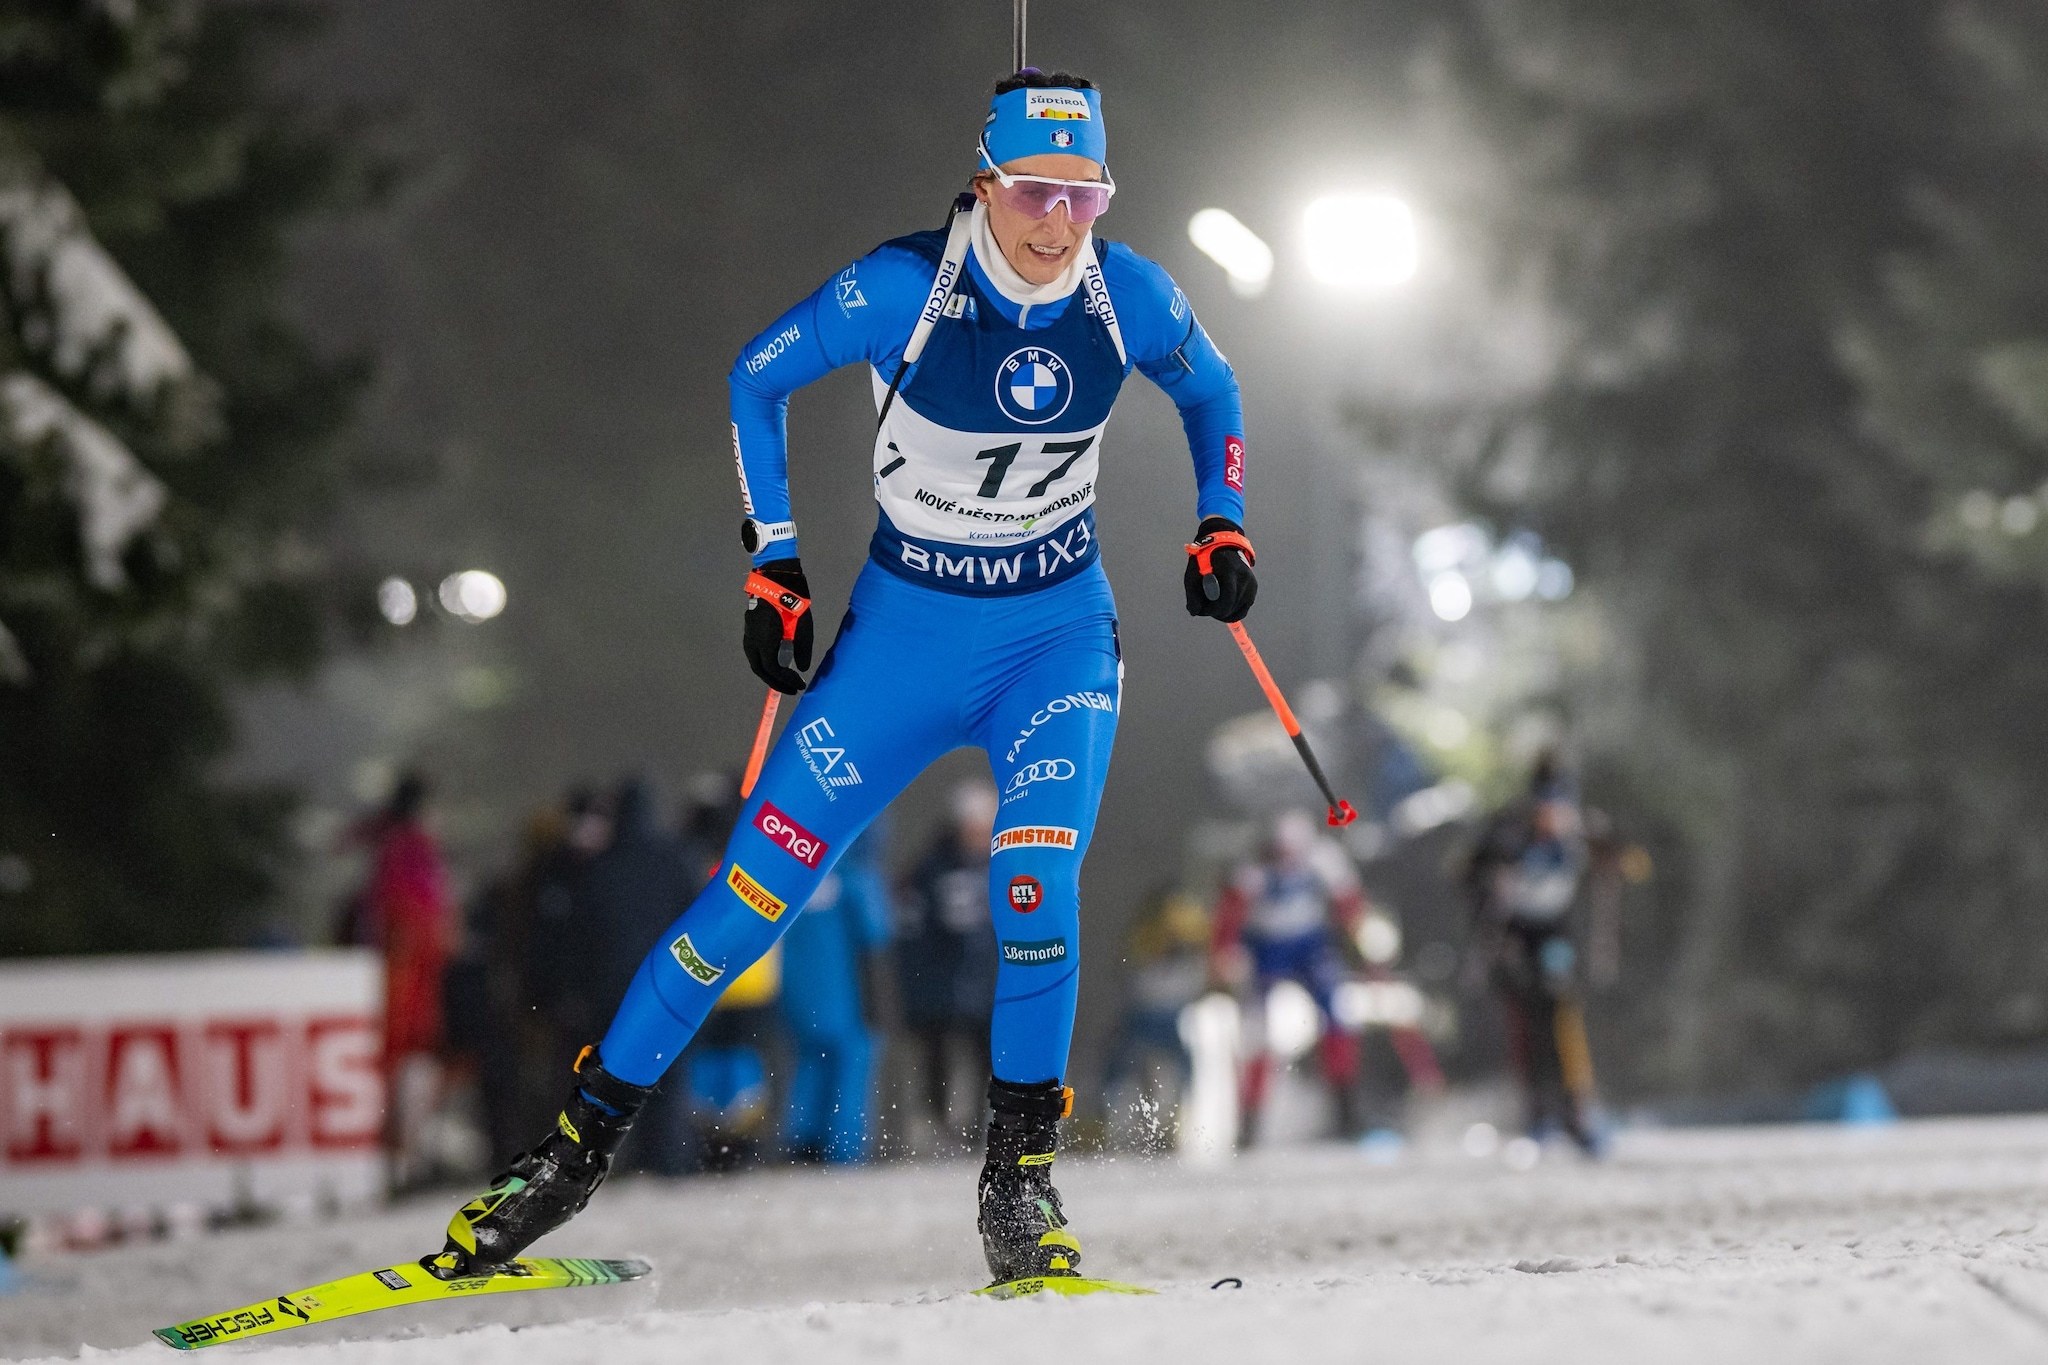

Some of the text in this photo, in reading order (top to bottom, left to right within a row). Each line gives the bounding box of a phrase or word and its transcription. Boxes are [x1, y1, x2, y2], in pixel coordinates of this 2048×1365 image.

[923, 259, 957, 324] FIOCCHI
[1085, 264, 1116, 328] FIOCCHI
[1169, 286, 1184, 321] EA
[745, 324, 802, 376] FALCONERI
[1006, 350, 1062, 373] BMW
[975, 434, 1096, 499] 17
[1227, 443, 1243, 488] enel
[914, 488, 957, 513] NOVÉ
[901, 518, 1091, 585] BMW iX3
[793, 731, 813, 764] EMPORIO
[1006, 691, 1113, 764] FALCONERI
[801, 716, 863, 787] EA7
[1002, 789, 1029, 807] Audi
[762, 815, 821, 864] enel
[1000, 828, 1073, 848] FINSTRAL
[731, 870, 781, 917] PIRELLI
[1011, 885, 1036, 897] RTL
[1013, 896, 1037, 904] 102.5
[673, 936, 722, 982] FORST
[443, 1279, 490, 1293] FISCHER
[1015, 1280, 1044, 1294] FISCHER
[175, 1307, 276, 1345] FISCHER
